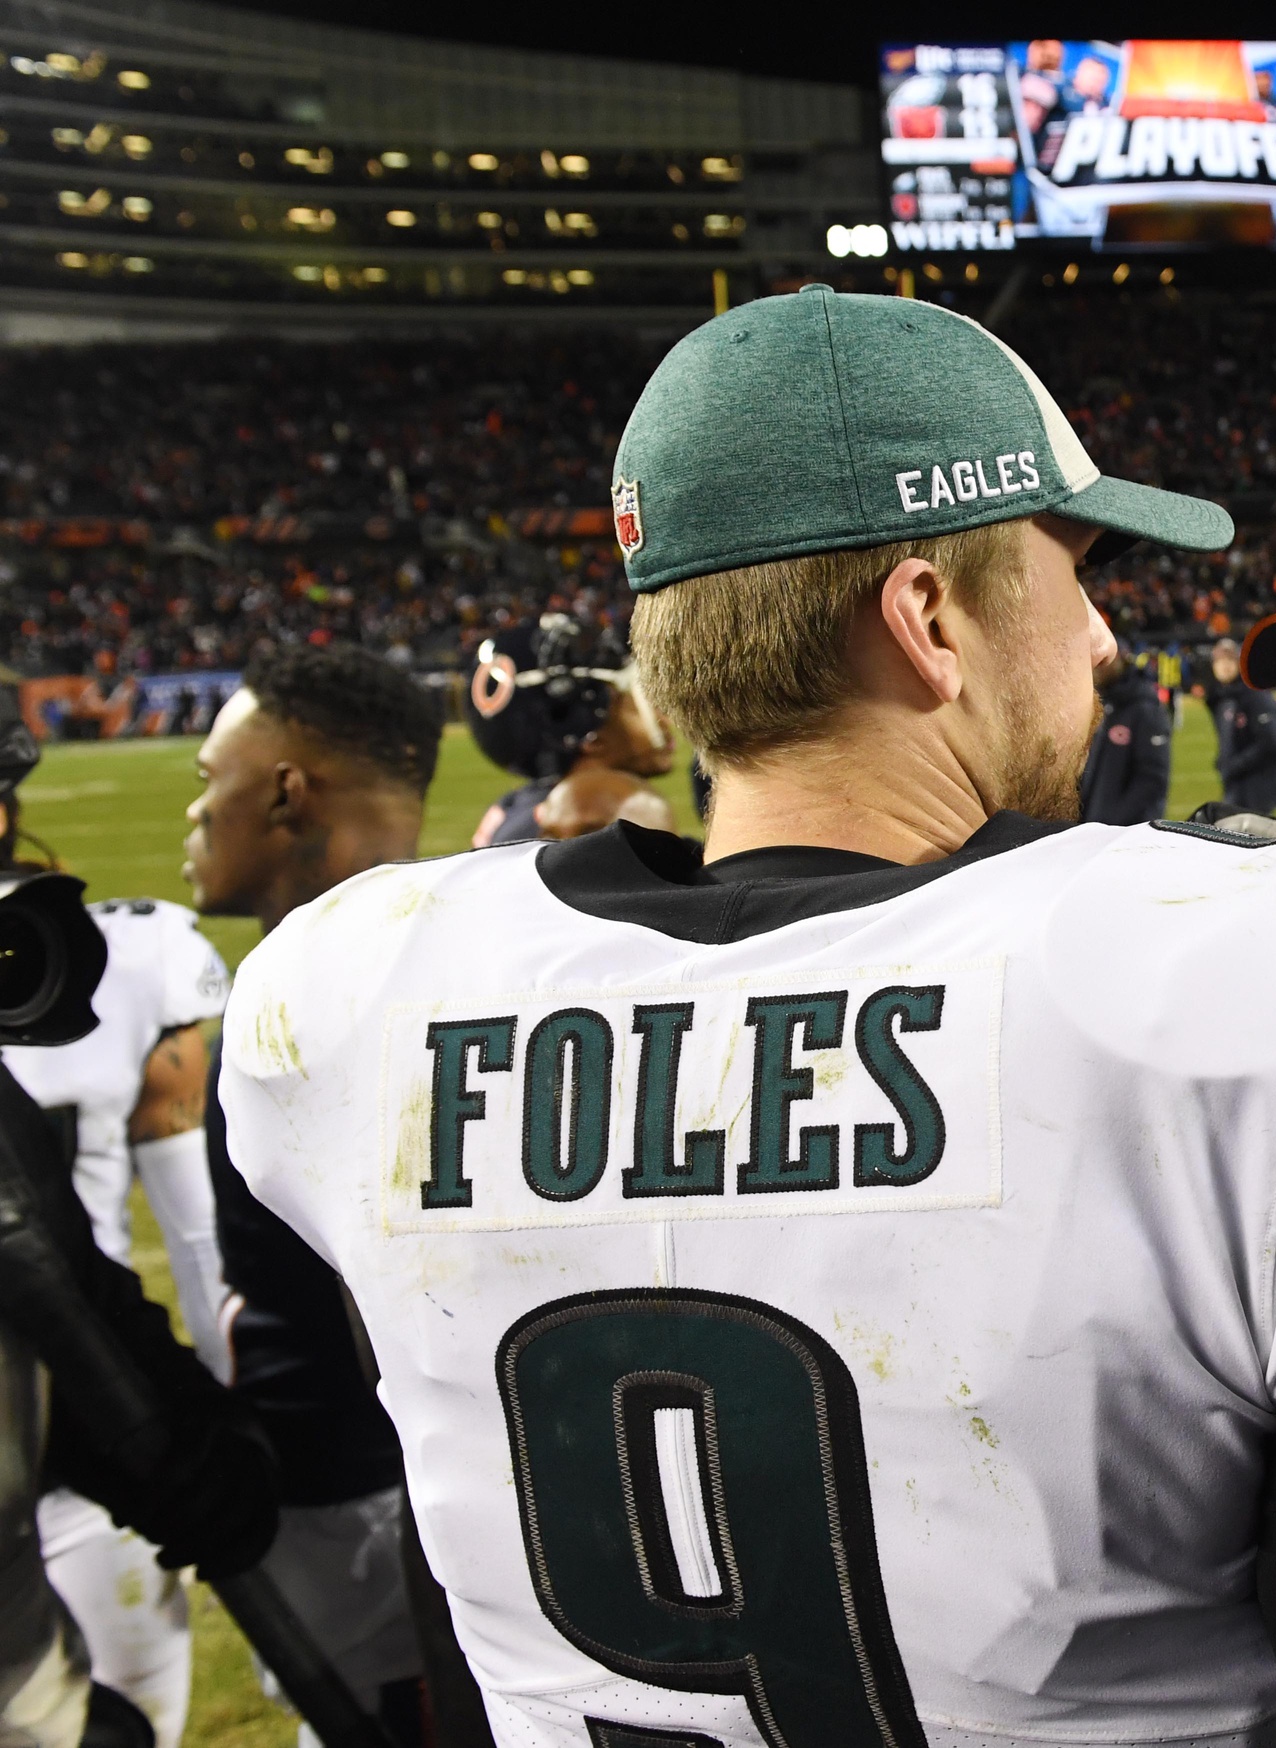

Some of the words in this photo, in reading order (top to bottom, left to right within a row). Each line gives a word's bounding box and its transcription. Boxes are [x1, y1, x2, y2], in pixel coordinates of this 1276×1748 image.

[896, 450, 1041, 513] EAGLES
[421, 984, 947, 1210] FOLES
[495, 1287, 929, 1748] 9
